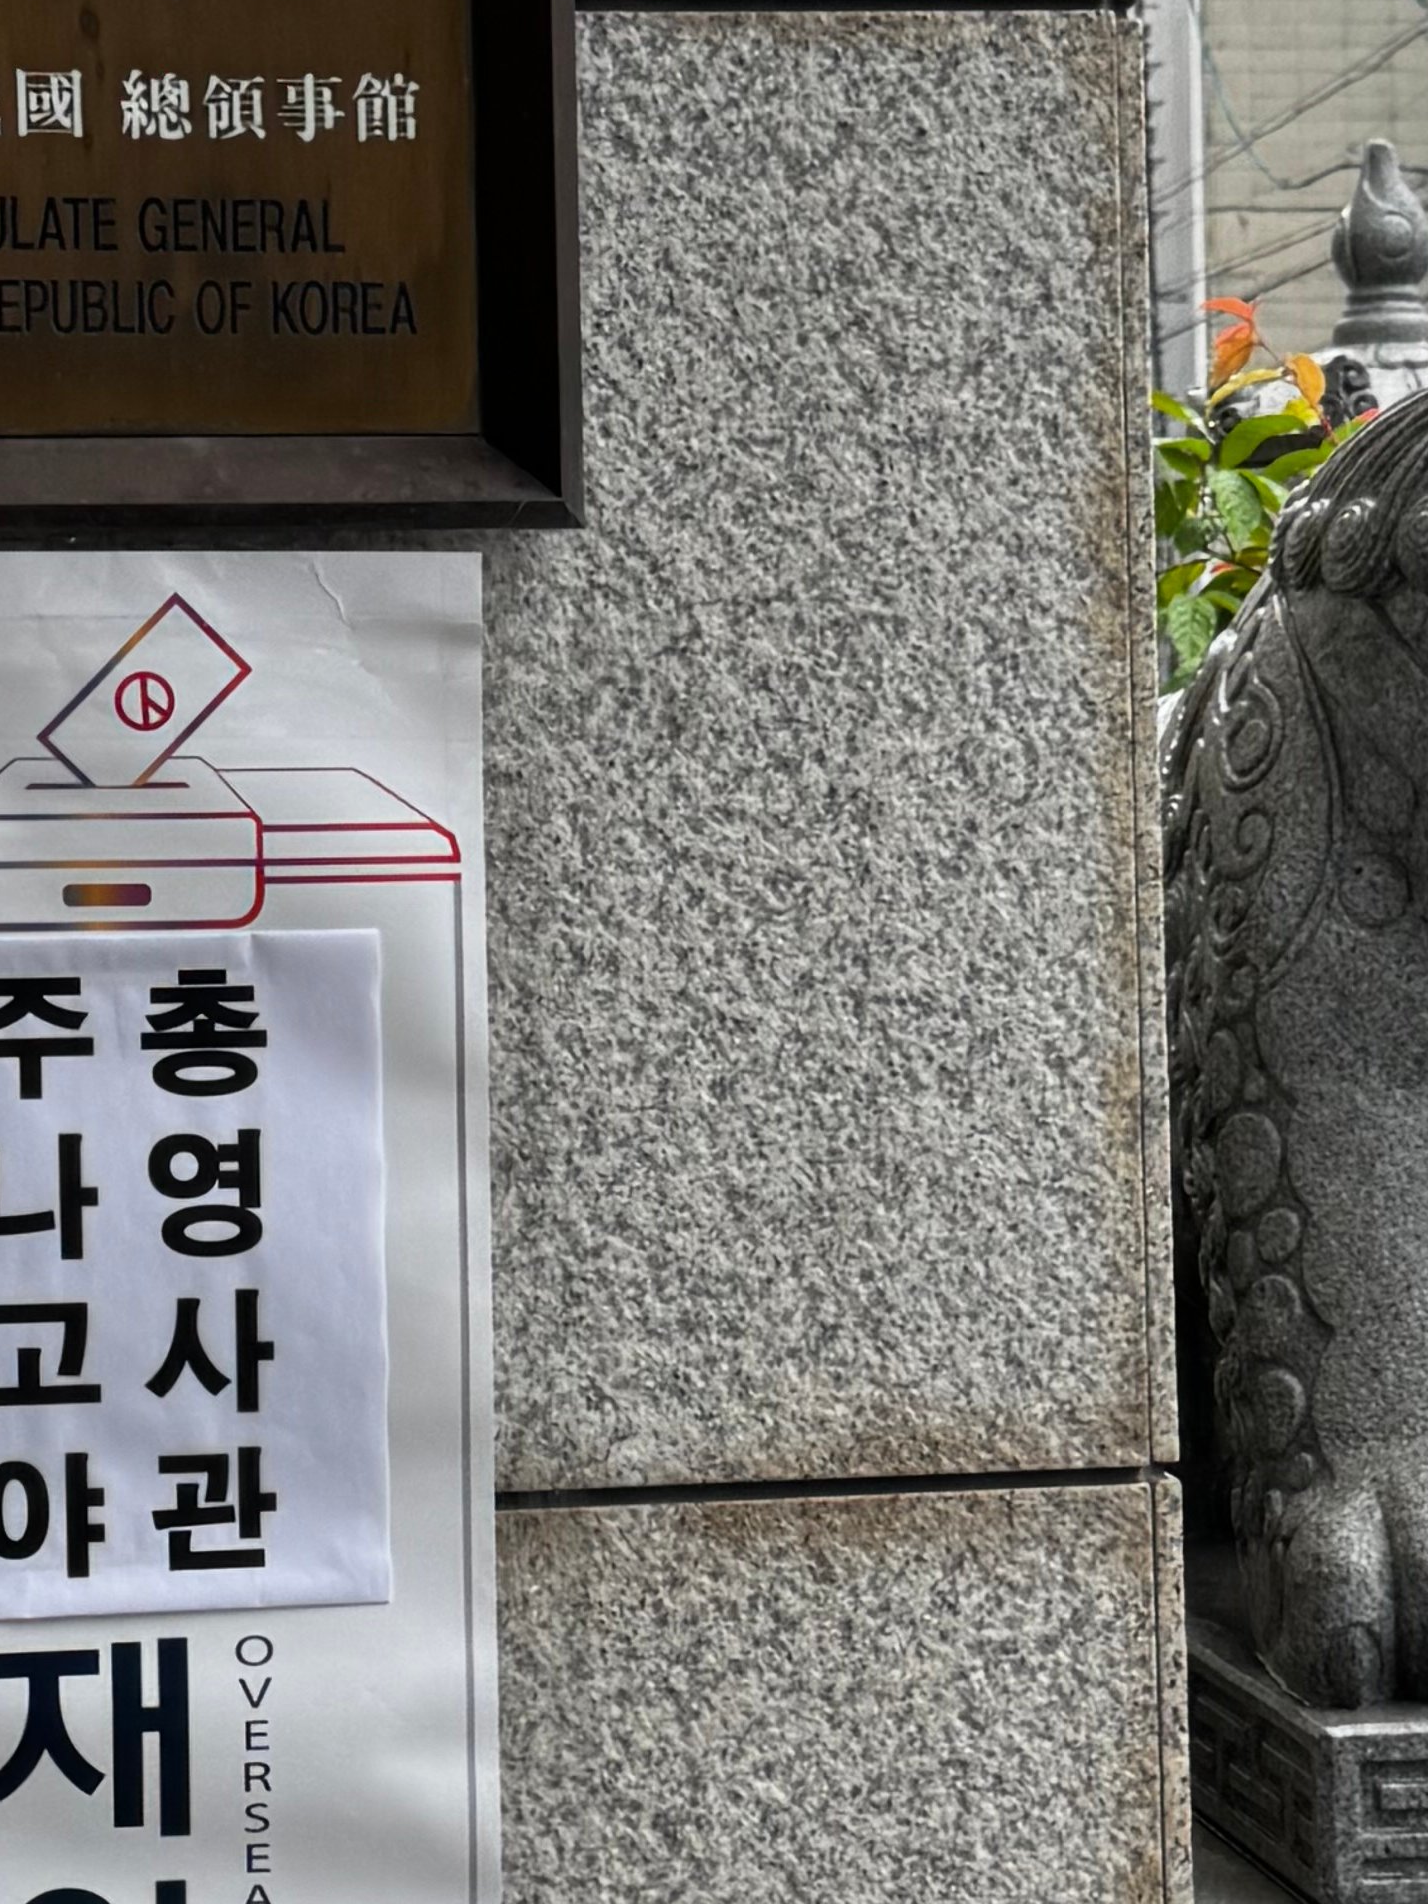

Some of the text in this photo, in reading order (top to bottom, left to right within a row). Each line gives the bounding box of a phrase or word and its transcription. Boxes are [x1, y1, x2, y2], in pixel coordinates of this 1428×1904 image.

[120, 68, 421, 143] 總領事館
[137, 196, 346, 255] GENERAL
[195, 280, 253, 336] OF
[271, 280, 418, 337] KOREA
[140, 969, 278, 1572] 총영사관
